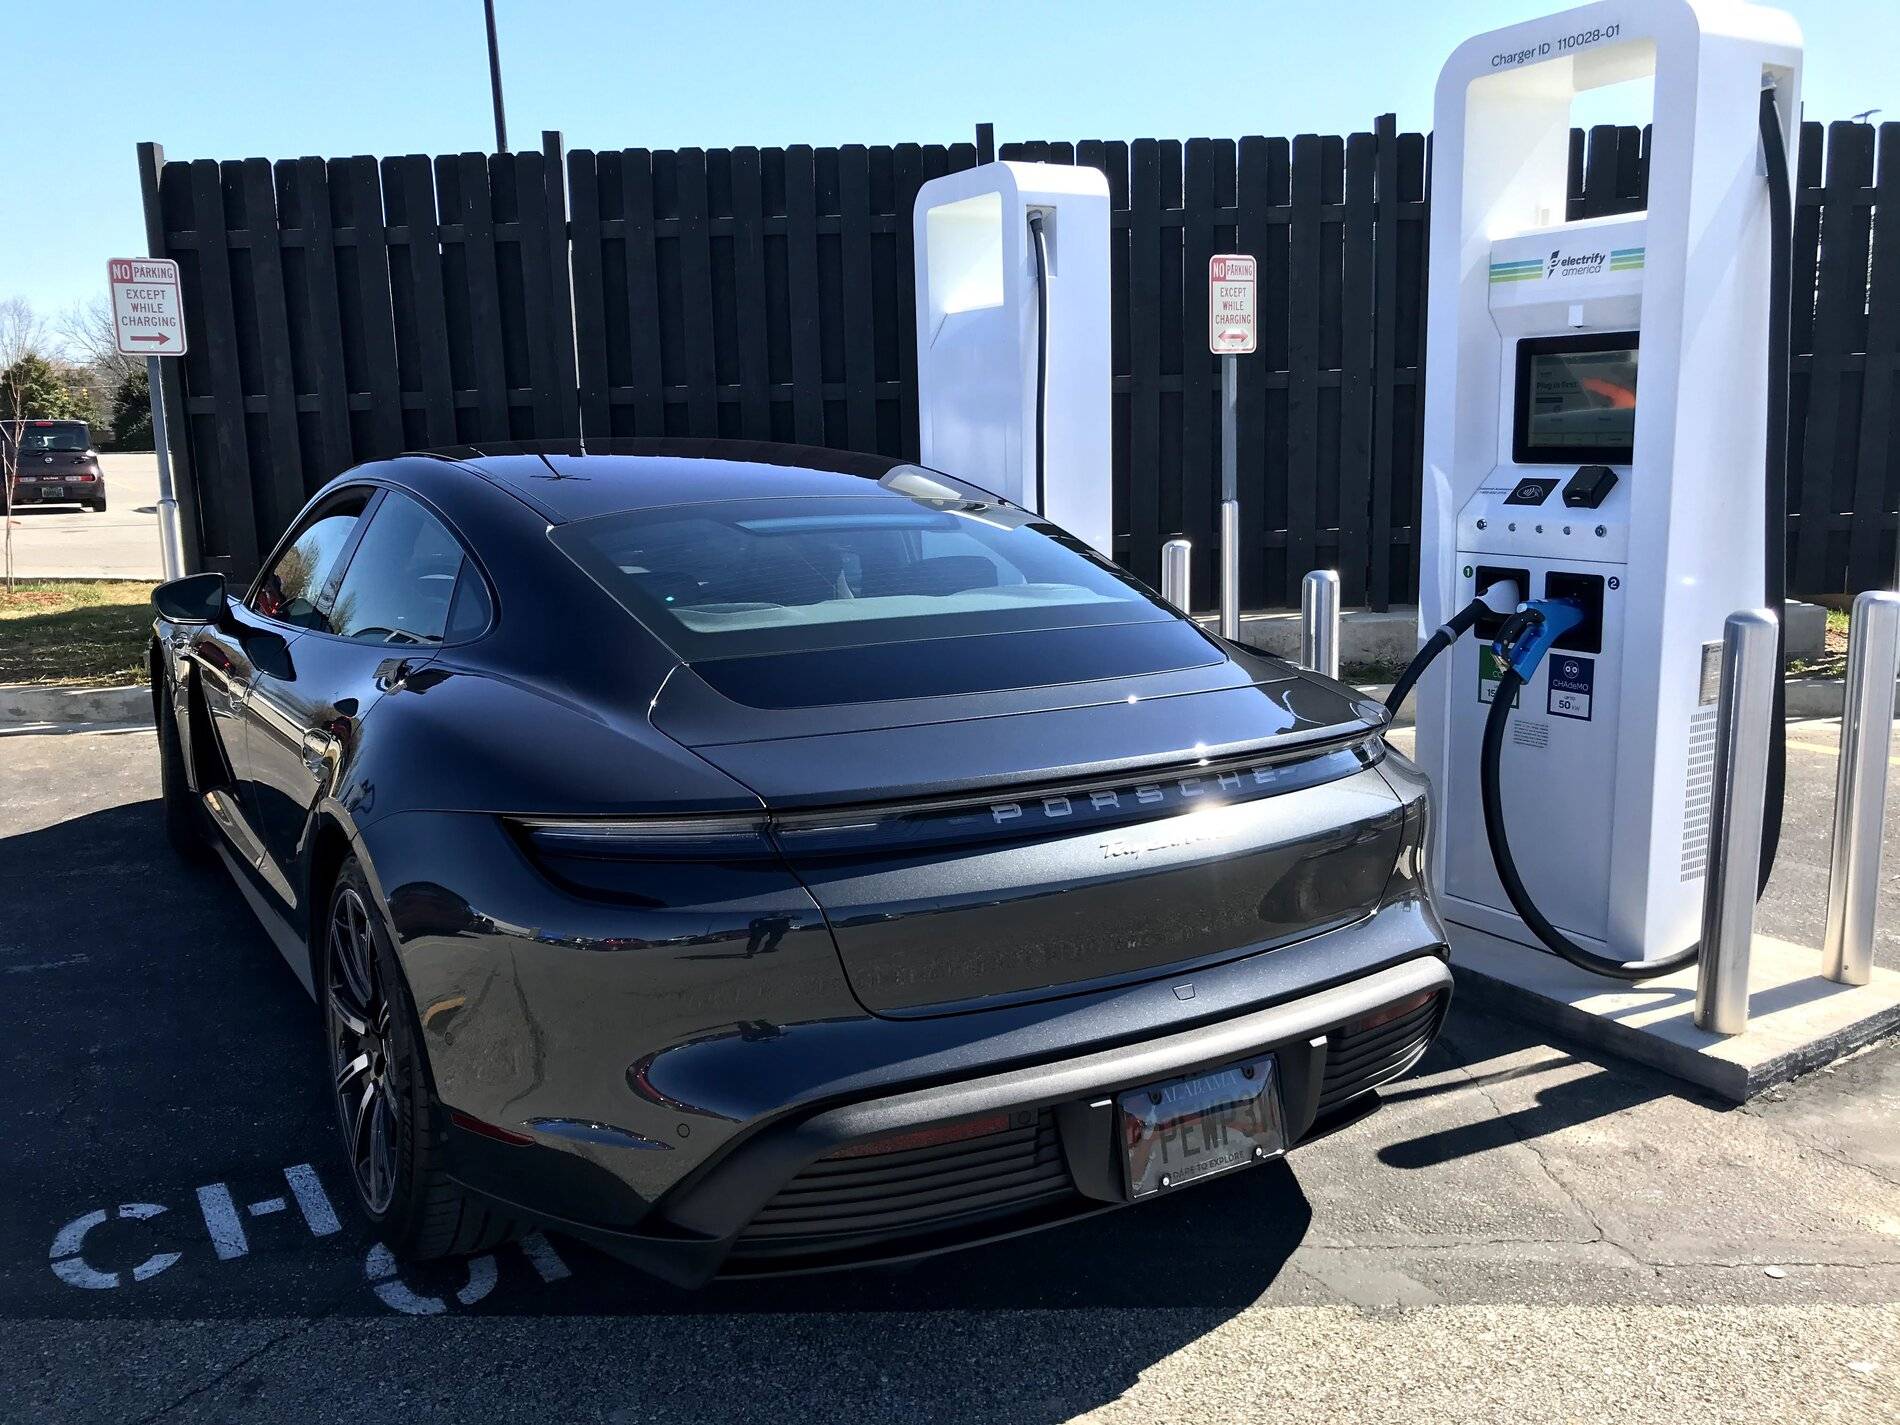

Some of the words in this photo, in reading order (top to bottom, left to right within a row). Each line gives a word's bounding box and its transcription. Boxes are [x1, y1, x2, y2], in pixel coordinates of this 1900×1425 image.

[1491, 47, 1536, 67] Charger
[1538, 42, 1551, 56] ID
[1557, 24, 1620, 50] 110028-01
[1561, 253, 1605, 267] electrify
[112, 264, 130, 280] NO
[134, 266, 173, 279] PARKING
[1213, 262, 1225, 278] NO
[1226, 264, 1252, 276] PARKING
[1562, 265, 1601, 277] america
[126, 289, 166, 300] EXCEPT
[1220, 287, 1246, 298] EXCEPT
[130, 302, 164, 314] WHILE
[1222, 301, 1244, 311] WHILE
[121, 316, 176, 327] CHARGING
[1215, 314, 1252, 325] CHARGING
[1610, 578, 1618, 588] 2
[1552, 679, 1589, 691] CHAdeMO
[1487, 689, 1496, 698] 15
[1558, 700, 1571, 710] 50
[990, 766, 1276, 823] PORSCHE
[1163, 1072, 1236, 1102] ALABAMA
[1197, 1163, 1209, 1174] TO
[1209, 1151, 1245, 1169] EXPLORE
